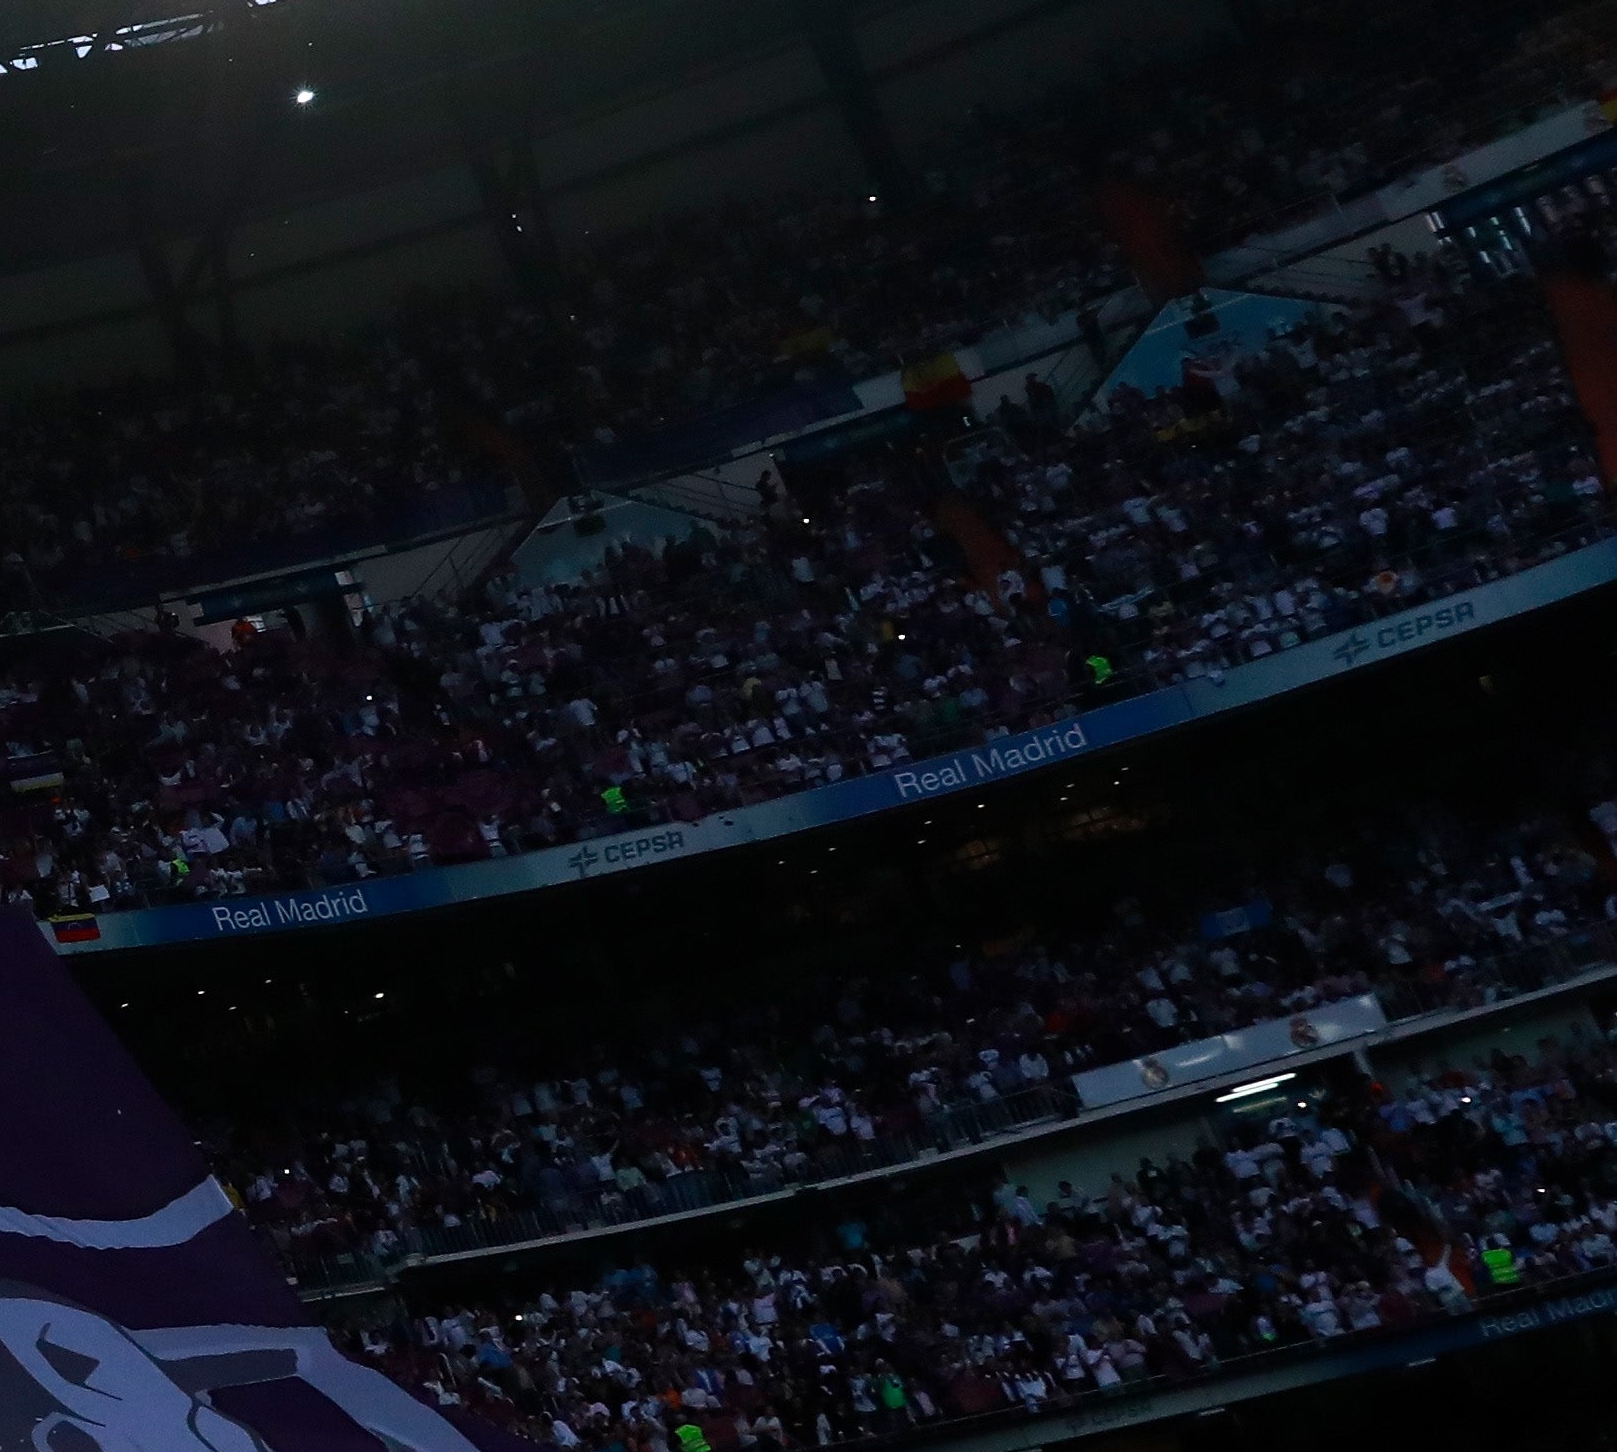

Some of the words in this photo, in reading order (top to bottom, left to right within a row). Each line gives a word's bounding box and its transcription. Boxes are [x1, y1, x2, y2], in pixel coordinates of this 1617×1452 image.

[1377, 601, 1475, 648] CEPSA
[894, 762, 965, 798] Real
[971, 723, 1087, 777] Madrid
[604, 830, 685, 864] CEPSA
[212, 903, 271, 931] Real
[279, 889, 368, 925] Madrid
